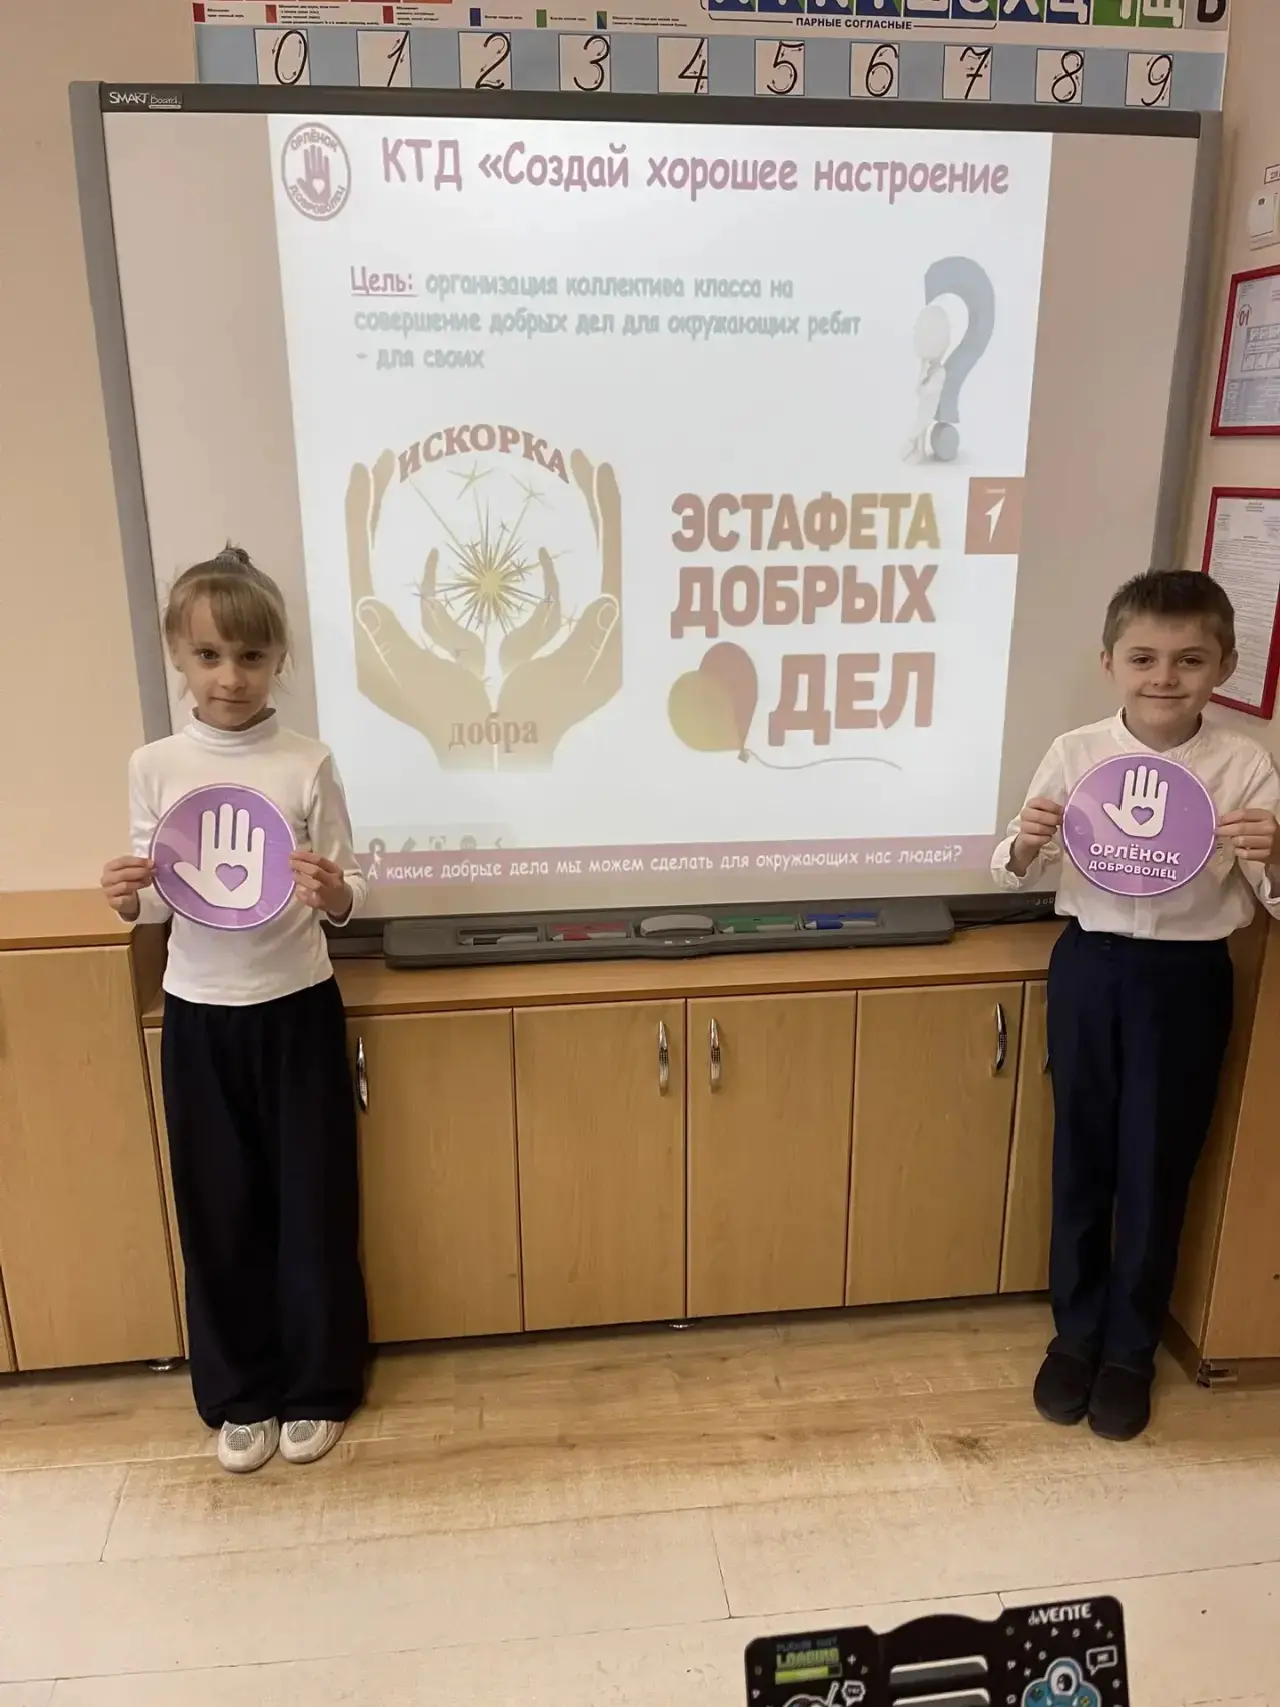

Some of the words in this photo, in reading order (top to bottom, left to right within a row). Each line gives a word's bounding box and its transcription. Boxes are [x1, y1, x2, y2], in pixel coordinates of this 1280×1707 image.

[796, 17, 842, 28] ПАРНЫЕ
[845, 19, 912, 30] СОГЛАСНЫЕ
[274, 30, 308, 85] 0
[387, 31, 410, 86] 1
[475, 33, 511, 89] 2
[573, 36, 611, 91] 3
[678, 38, 709, 93] 4
[767, 41, 805, 94] 5
[865, 44, 899, 96] 6
[960, 46, 992, 99] 7
[1051, 50, 1084, 103] 8
[1141, 54, 1172, 107] 9
[109, 91, 149, 104] SMART
[382, 136, 463, 191] КТД
[478, 141, 629, 193] «Создай
[647, 156, 798, 202] хорошее
[813, 159, 1010, 205] настроение
[350, 265, 414, 296] Цель:
[425, 273, 559, 302] организация
[565, 275, 685, 299] коллектива
[694, 277, 762, 299] класса
[770, 279, 794, 299] на
[353, 311, 482, 339] совершение
[489, 306, 568, 340] добрых
[575, 312, 615, 336] дел
[622, 313, 660, 336] для
[667, 313, 801, 341] окружающих
[807, 308, 862, 342] ребят
[376, 348, 415, 371] для
[423, 348, 486, 370] своих
[398, 423, 570, 485] ИСКОРКА
[671, 491, 941, 552] ЭСТАФЕТА
[670, 564, 939, 639] ДОБРЫХ
[768, 652, 936, 746] ДЕЛ
[447, 711, 539, 754] добра
[367, 863, 379, 880] А
[386, 865, 434, 881] какие
[441, 859, 502, 884] добрые
[509, 861, 549, 877] дела
[555, 860, 582, 875] мы
[588, 857, 645, 874] можем
[650, 855, 714, 872] сделать
[720, 854, 749, 870] для
[756, 852, 859, 873] окружающих
[865, 850, 892, 865] нас
[898, 845, 964, 864] людей?
[1088, 859, 1178, 881] ДОБРОВОЛЕЦ
[1089, 843, 1182, 866] ОРЛЁНОК
